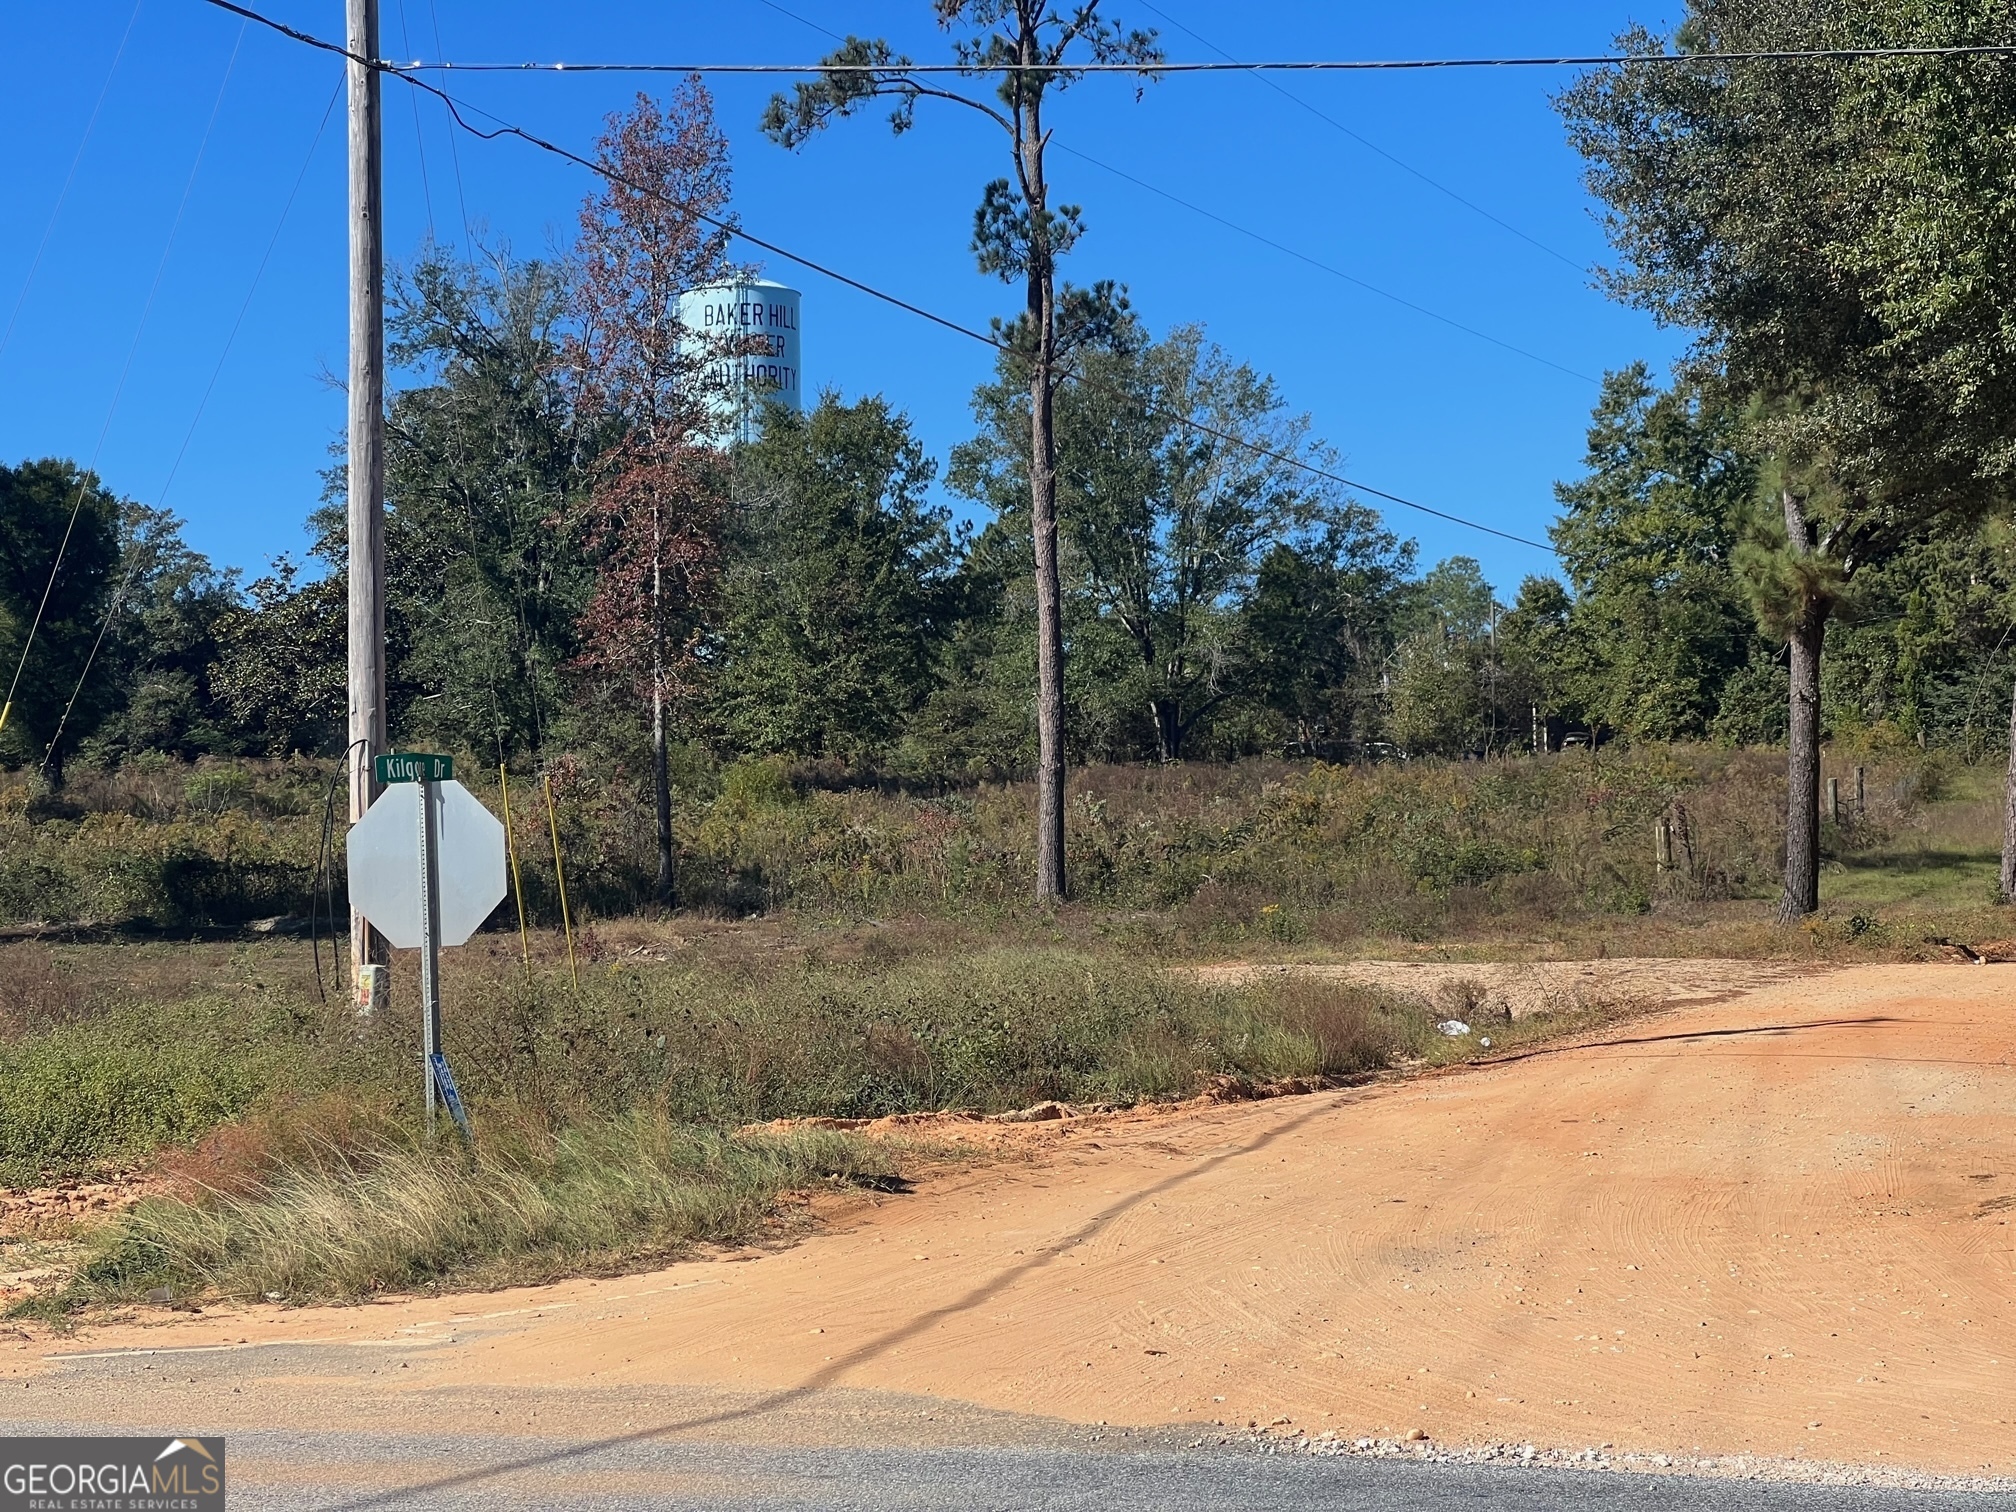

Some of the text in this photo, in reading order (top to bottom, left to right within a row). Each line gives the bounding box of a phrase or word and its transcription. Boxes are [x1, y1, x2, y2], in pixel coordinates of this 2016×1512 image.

[704, 303, 797, 330] BAKER HILL
[434, 758, 446, 779] Dr
